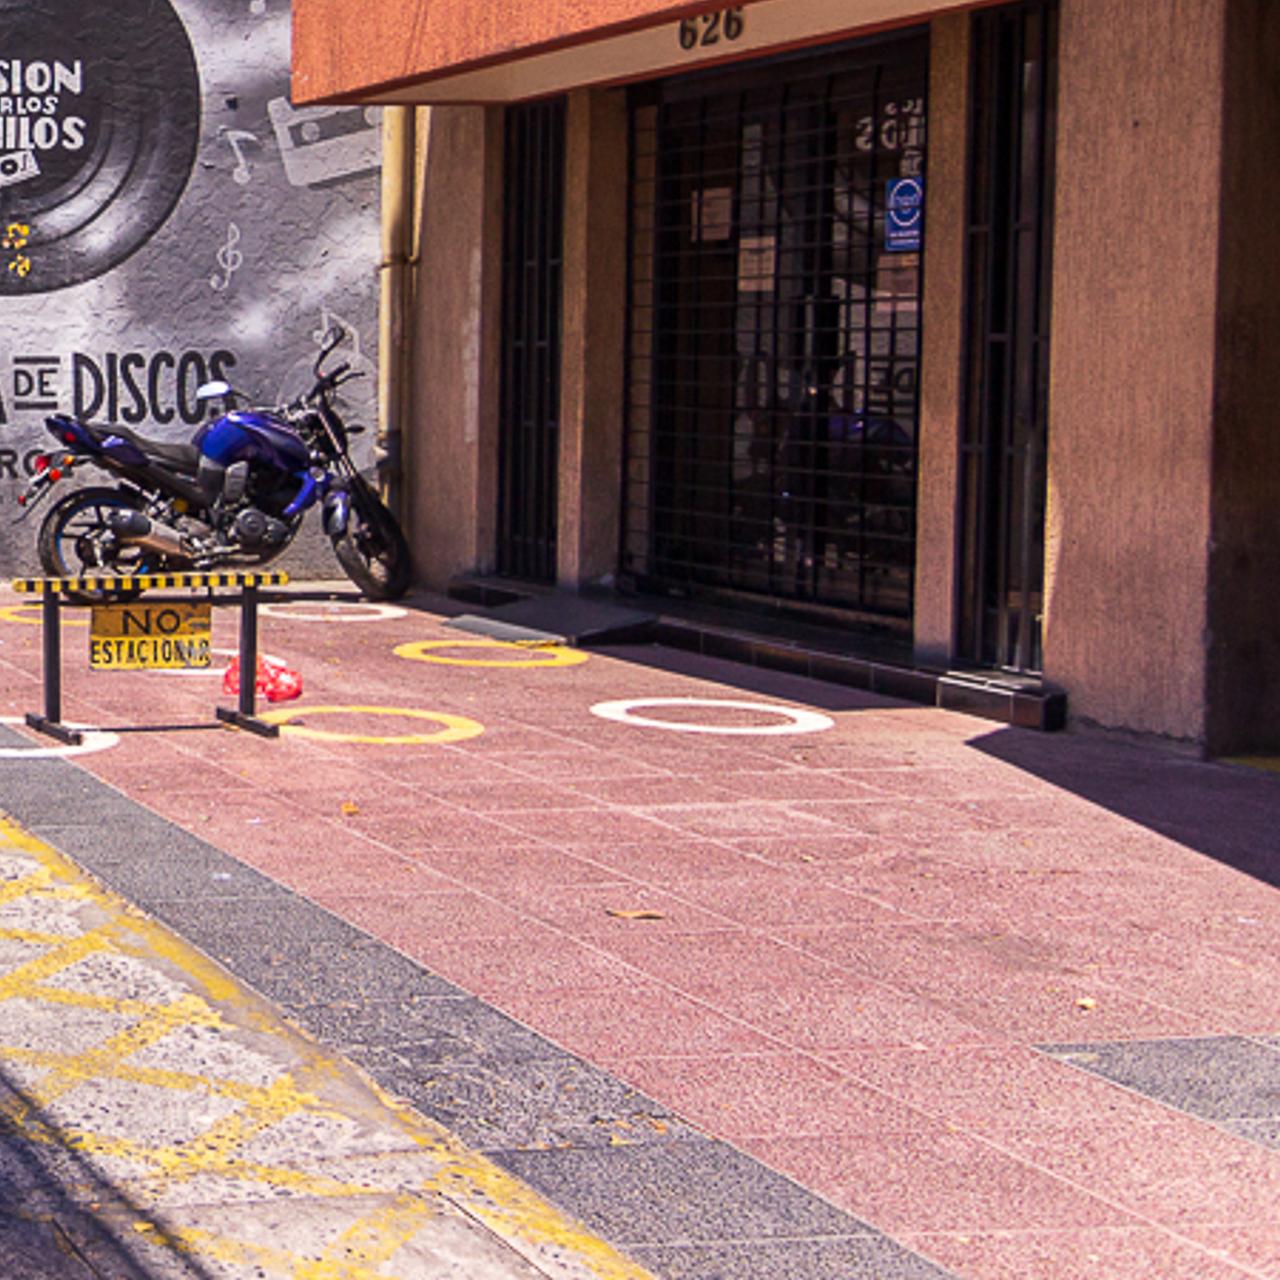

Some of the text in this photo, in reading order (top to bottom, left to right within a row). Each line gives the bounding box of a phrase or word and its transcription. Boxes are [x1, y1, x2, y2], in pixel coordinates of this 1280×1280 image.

[679, 6, 743, 50] 626
[16, 95, 59, 115] LOS
[13, 368, 58, 398] DE
[73, 350, 237, 424] DISCOS
[122, 608, 181, 636] NO
